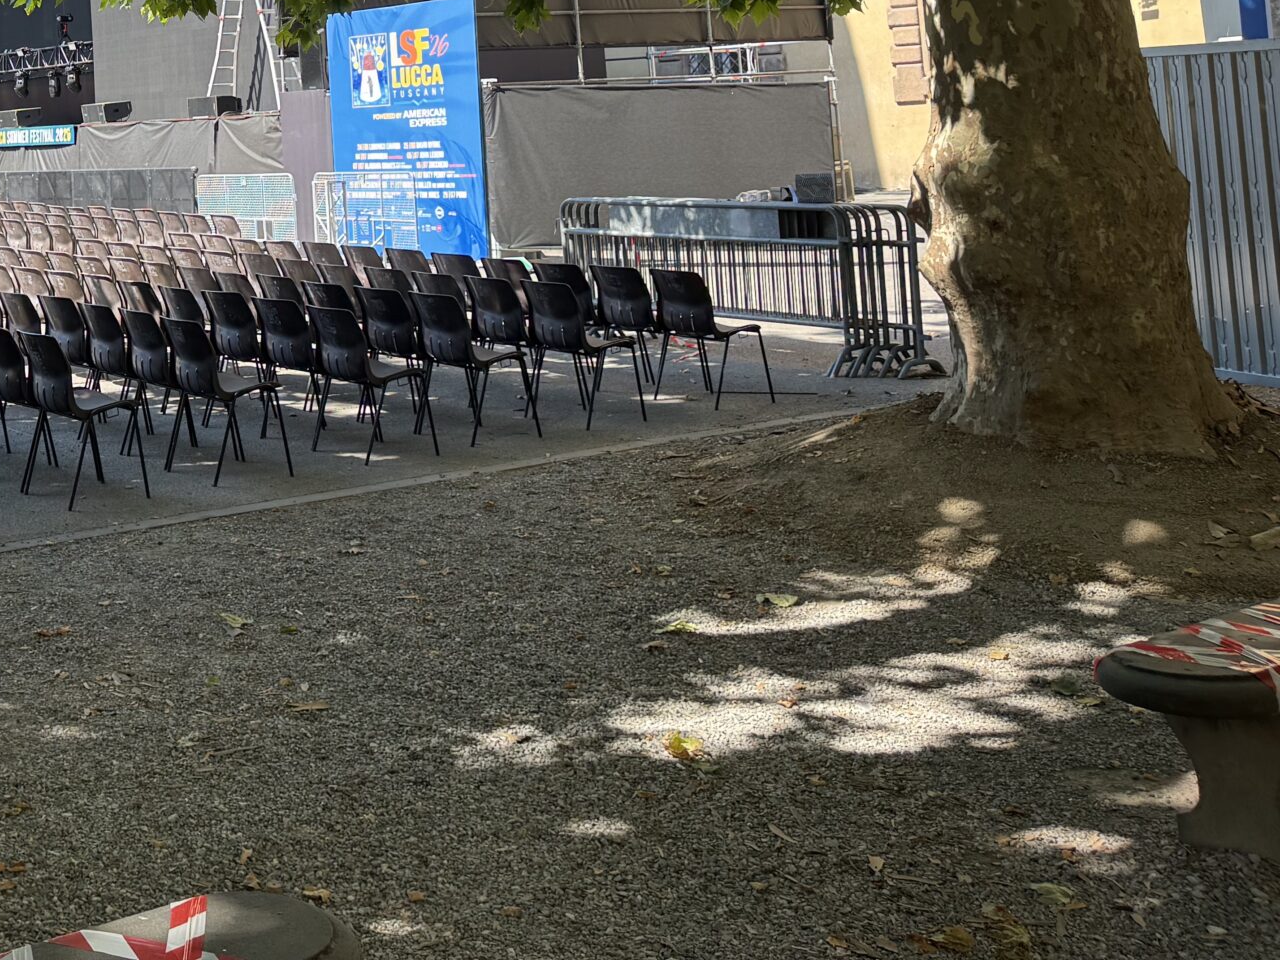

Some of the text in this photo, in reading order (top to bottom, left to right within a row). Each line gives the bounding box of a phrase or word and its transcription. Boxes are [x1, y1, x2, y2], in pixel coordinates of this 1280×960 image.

[389, 28, 429, 67] LSF
[391, 63, 444, 88] LUCCA
[393, 87, 444, 98] TUSCANY
[403, 107, 446, 119] AMERICAN
[409, 117, 447, 127] EXPRESS
